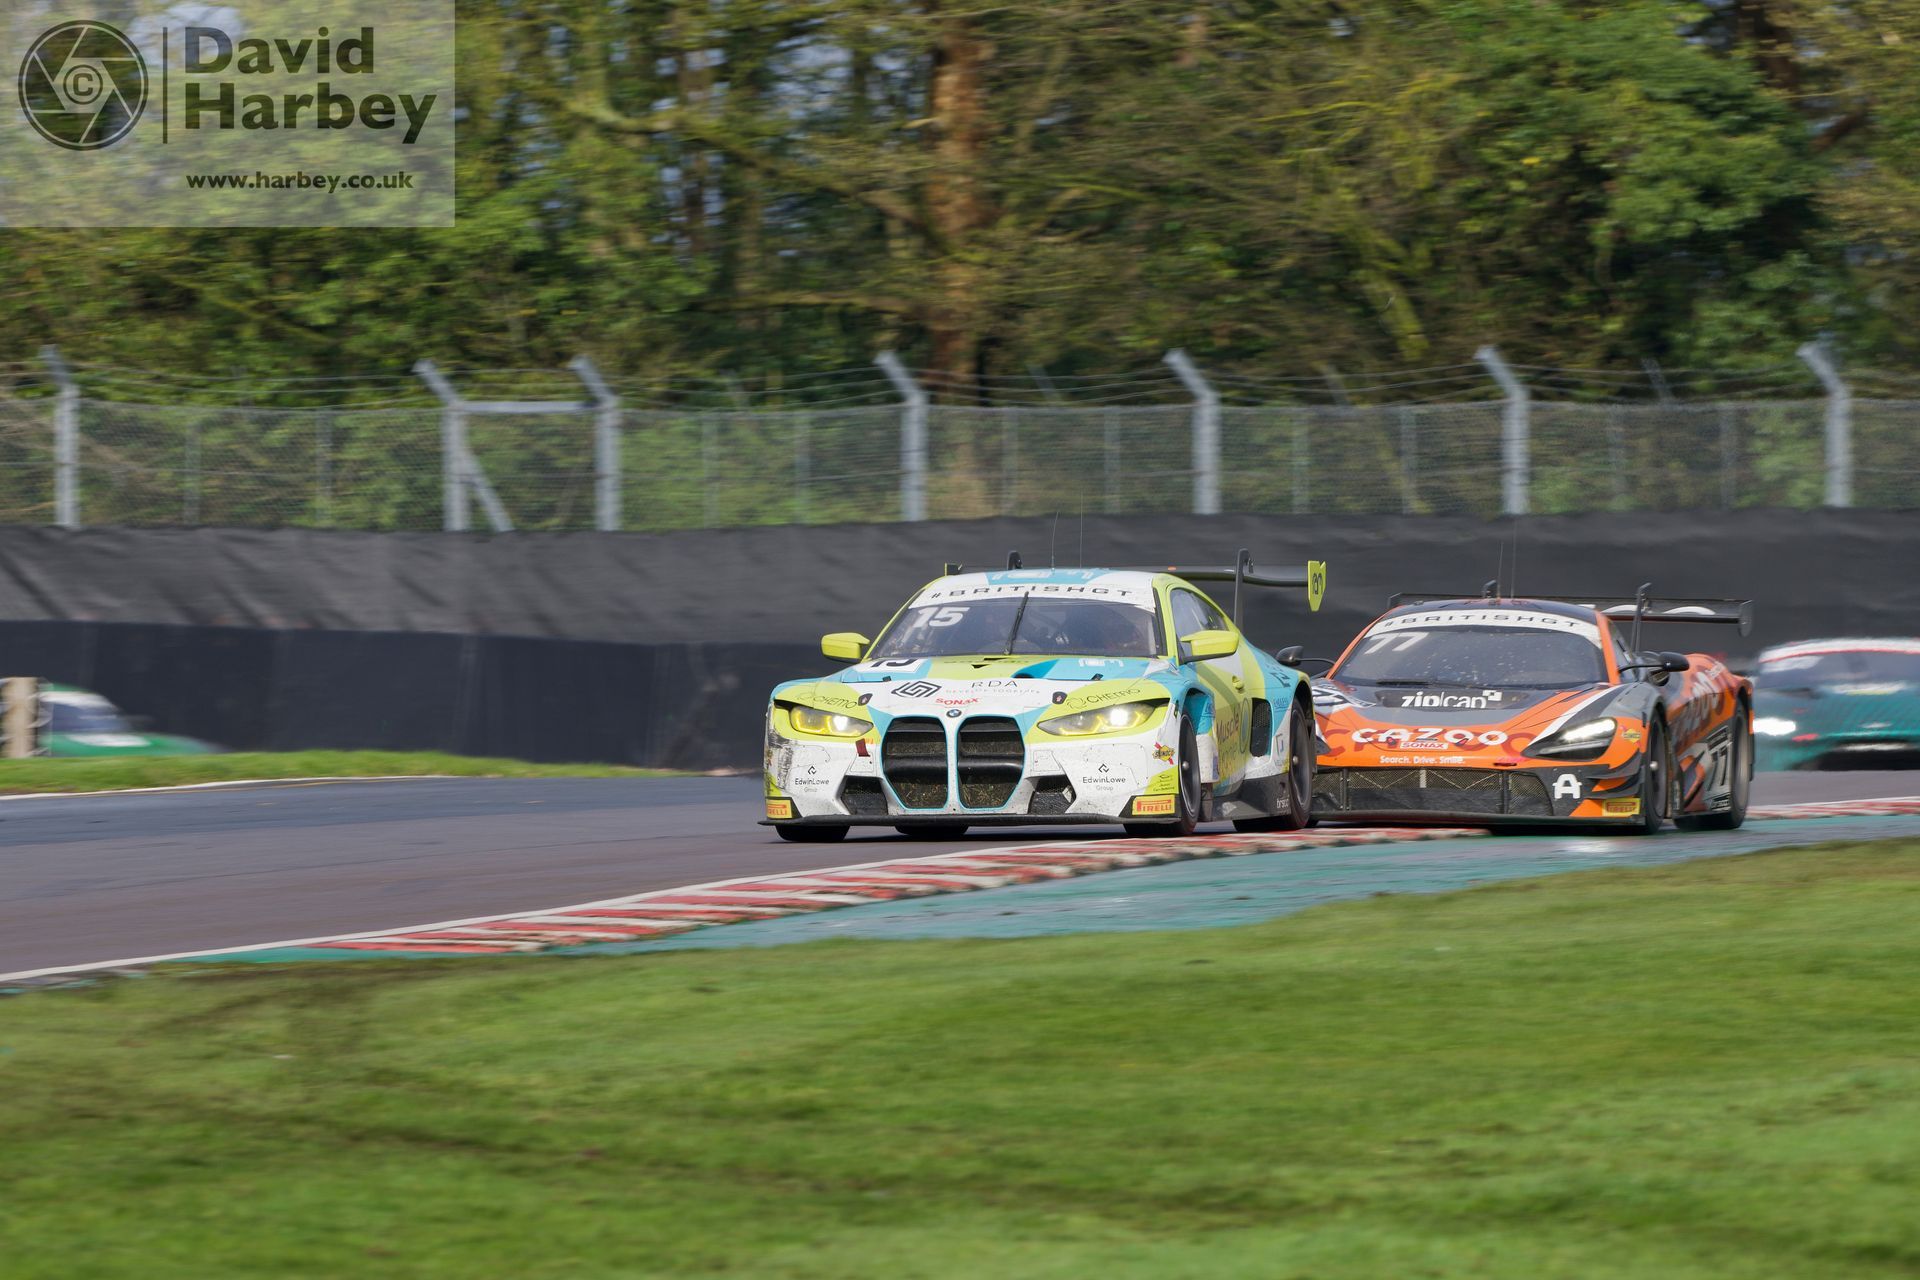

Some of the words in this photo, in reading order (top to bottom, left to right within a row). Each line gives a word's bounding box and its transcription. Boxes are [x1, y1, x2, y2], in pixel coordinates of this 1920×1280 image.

[913, 606, 970, 628] 15
[1363, 631, 1429, 655] 77
[971, 680, 1018, 688] RDA
[935, 697, 980, 705] SONAX
[1351, 728, 1508, 745] CAZOO
[1380, 755, 1410, 764] Search.
[1413, 756, 1437, 764] Drive.
[1439, 756, 1466, 764] Smile.
[1082, 776, 1126, 784] EdwinLowe
[1552, 773, 1583, 799] A
[1136, 799, 1172, 812] PIRELLI
